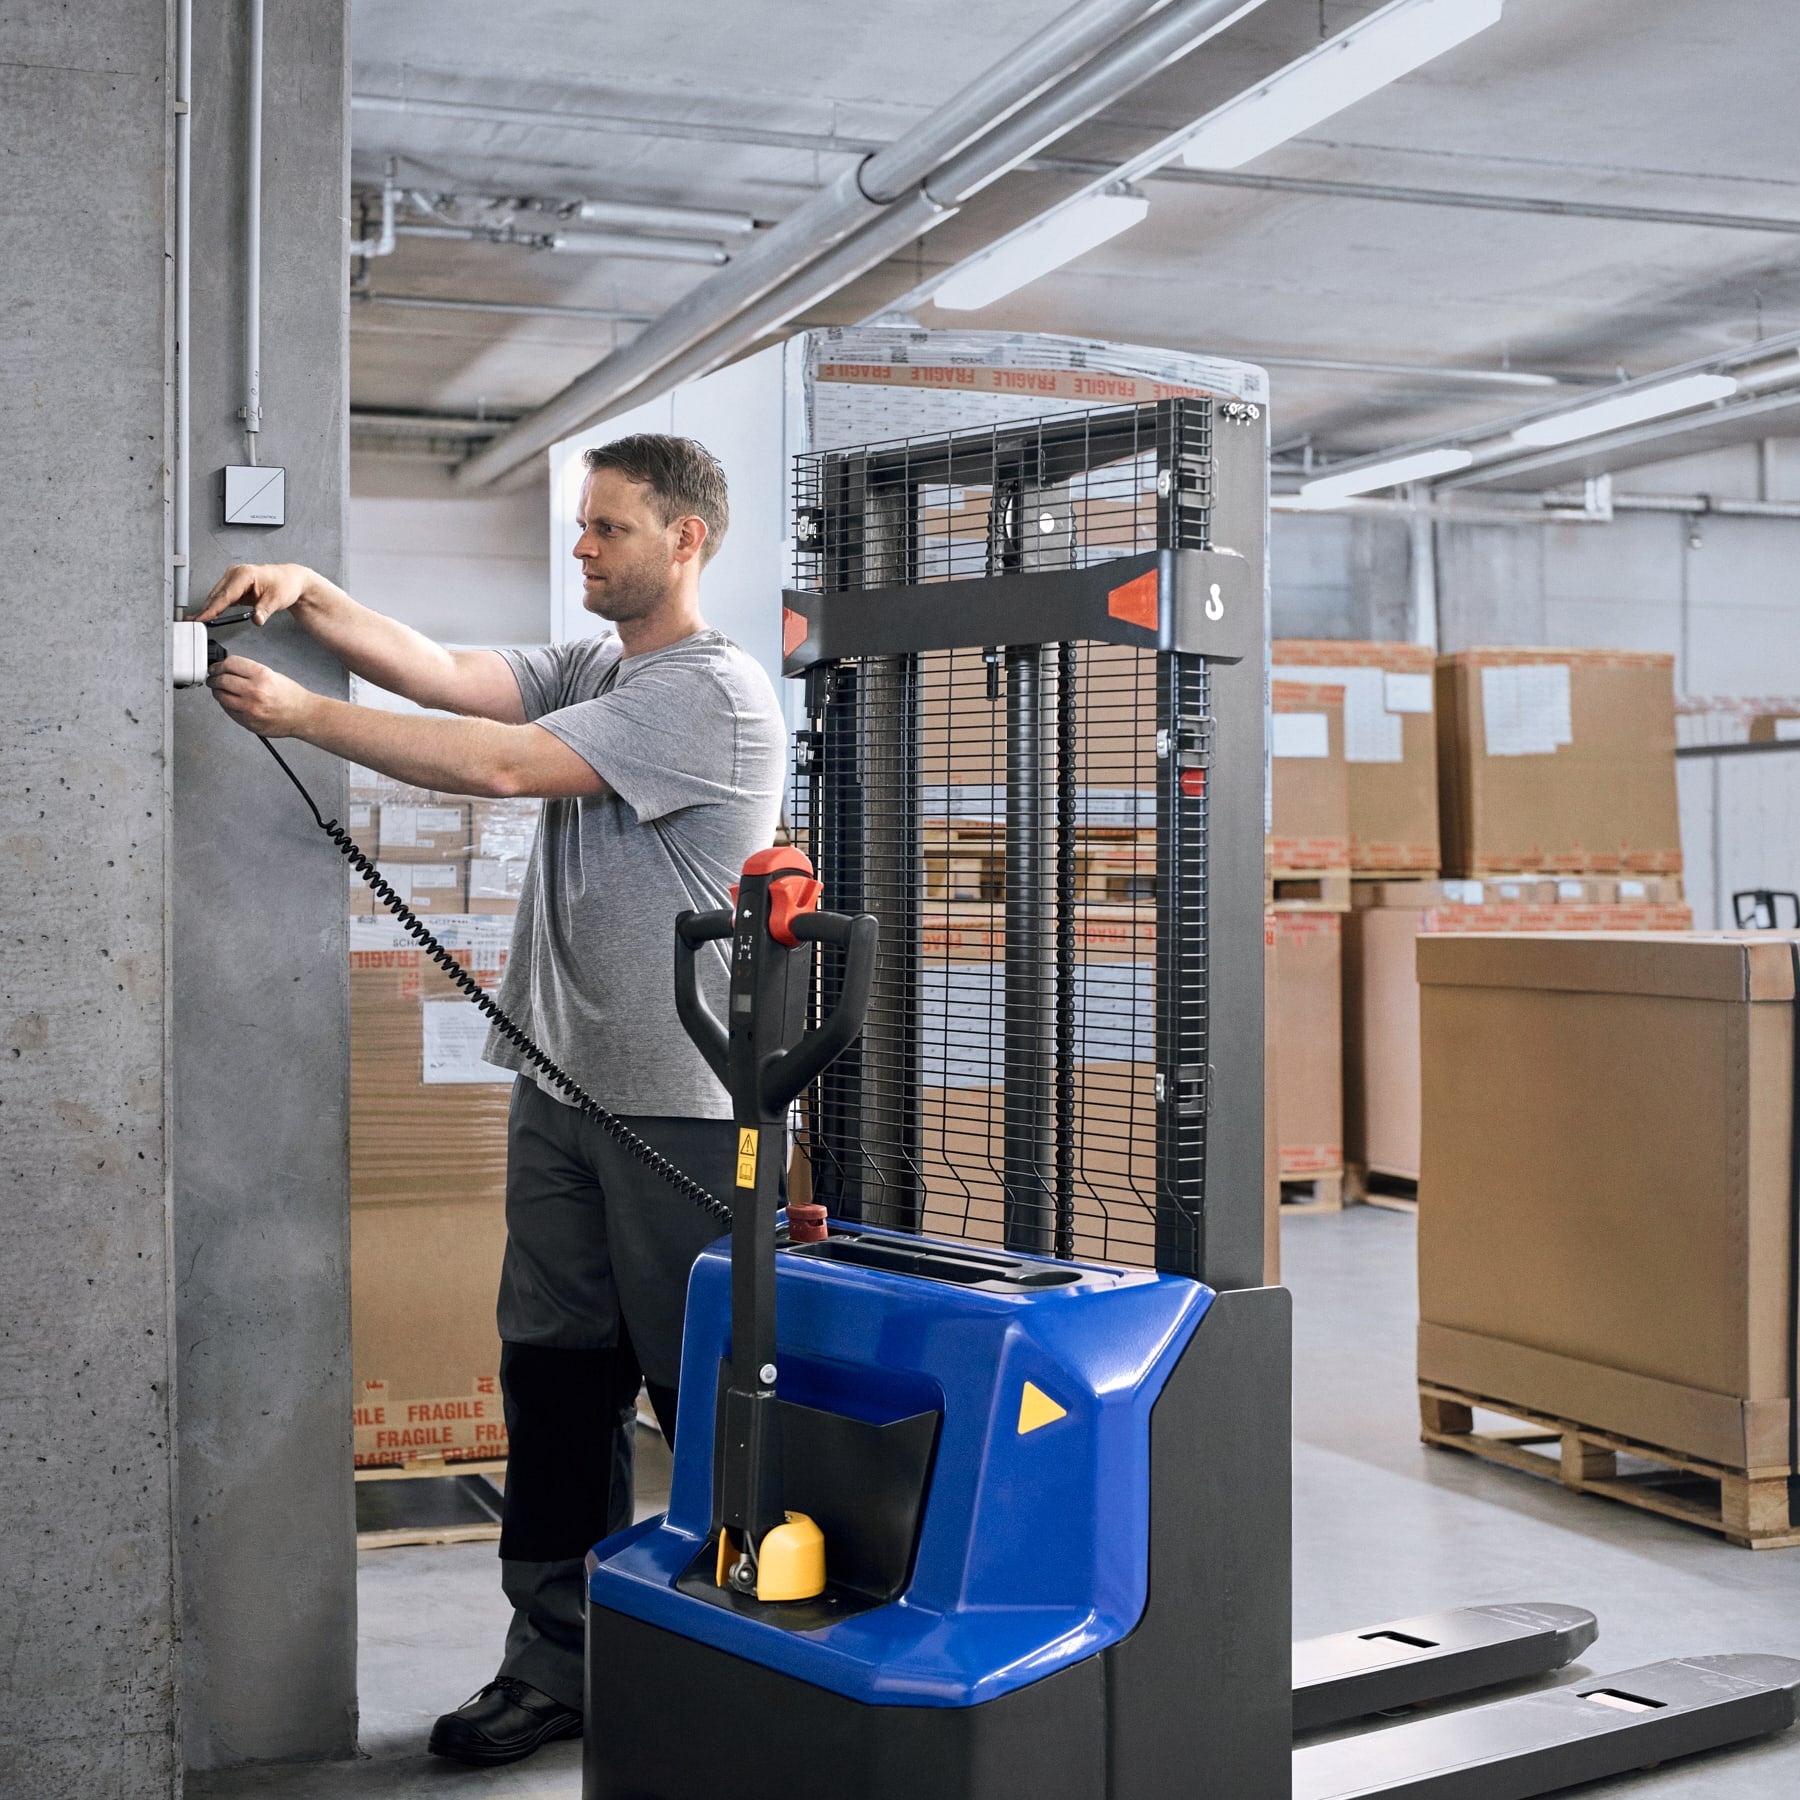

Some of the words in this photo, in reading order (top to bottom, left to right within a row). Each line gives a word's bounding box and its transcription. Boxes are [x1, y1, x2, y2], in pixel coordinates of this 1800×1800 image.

[826, 364, 892, 379] FRAGILE
[911, 366, 976, 384] FRAGILE
[993, 370, 1057, 390] FRAGILE
[1075, 377, 1137, 397] FRAGILE
[350, 950, 420, 967] FRAGIL
[407, 1401, 485, 1423] FRAGILE
[376, 1426, 453, 1449] FRAGILE
